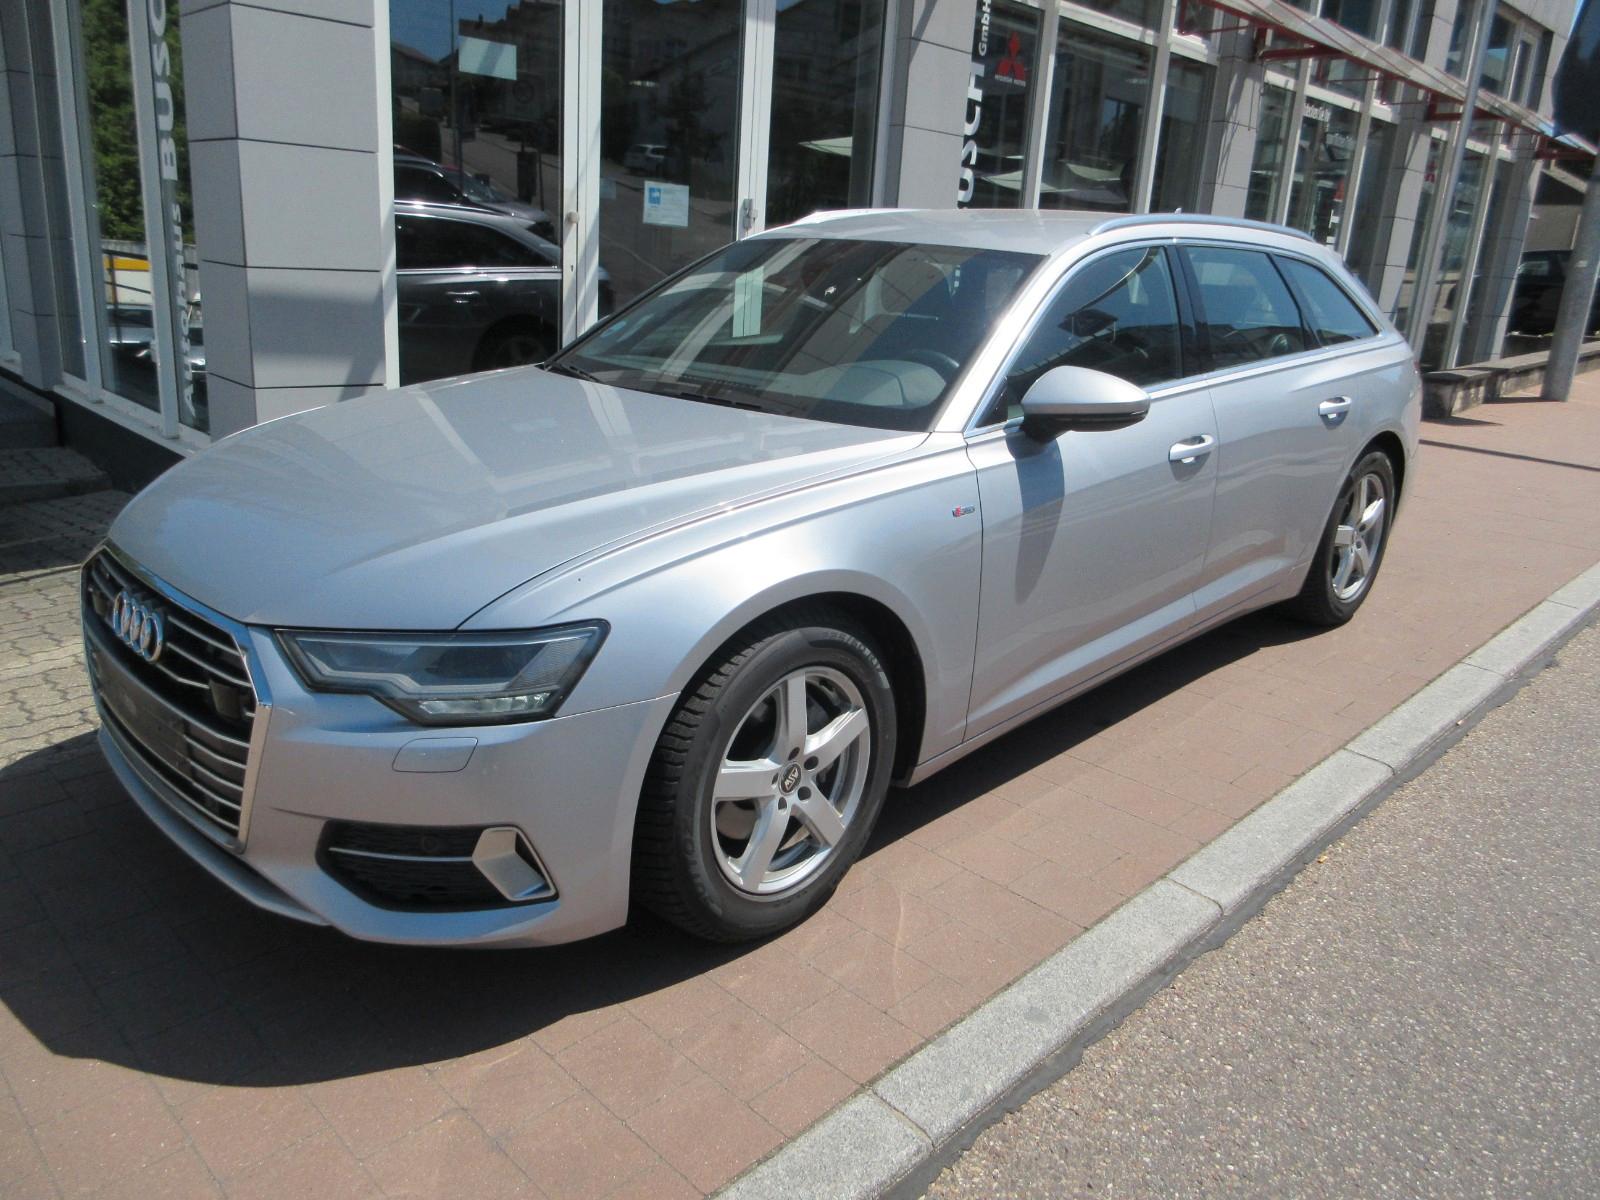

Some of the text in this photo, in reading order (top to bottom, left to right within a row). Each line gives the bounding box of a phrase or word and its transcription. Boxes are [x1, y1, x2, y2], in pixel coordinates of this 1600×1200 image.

[957, 0, 992, 210] USCH GmbH
[171, 202, 196, 417] Autohaus
